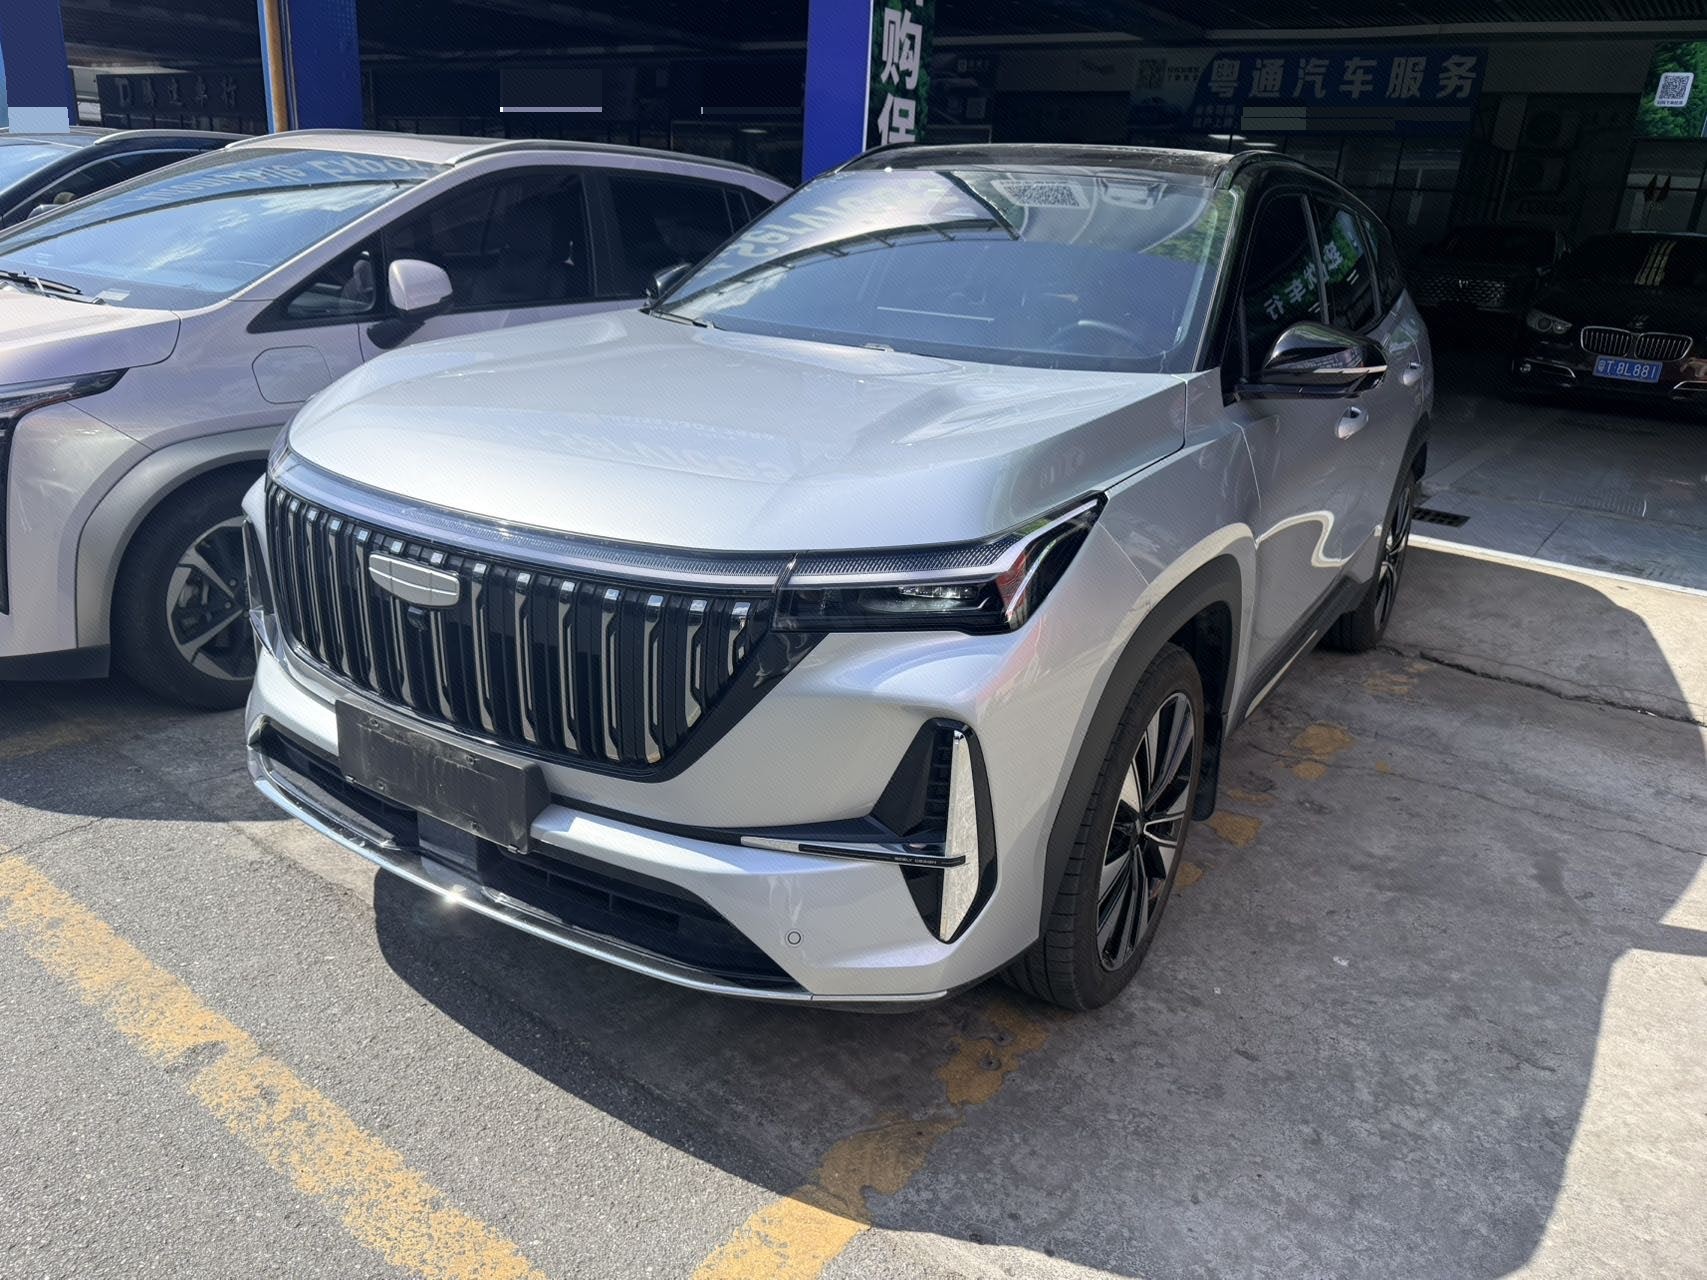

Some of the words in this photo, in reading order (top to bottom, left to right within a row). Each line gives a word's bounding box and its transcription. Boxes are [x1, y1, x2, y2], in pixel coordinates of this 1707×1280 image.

[877, 0, 924, 146] 购保
[1207, 55, 1477, 98] 粤通汽车服务
